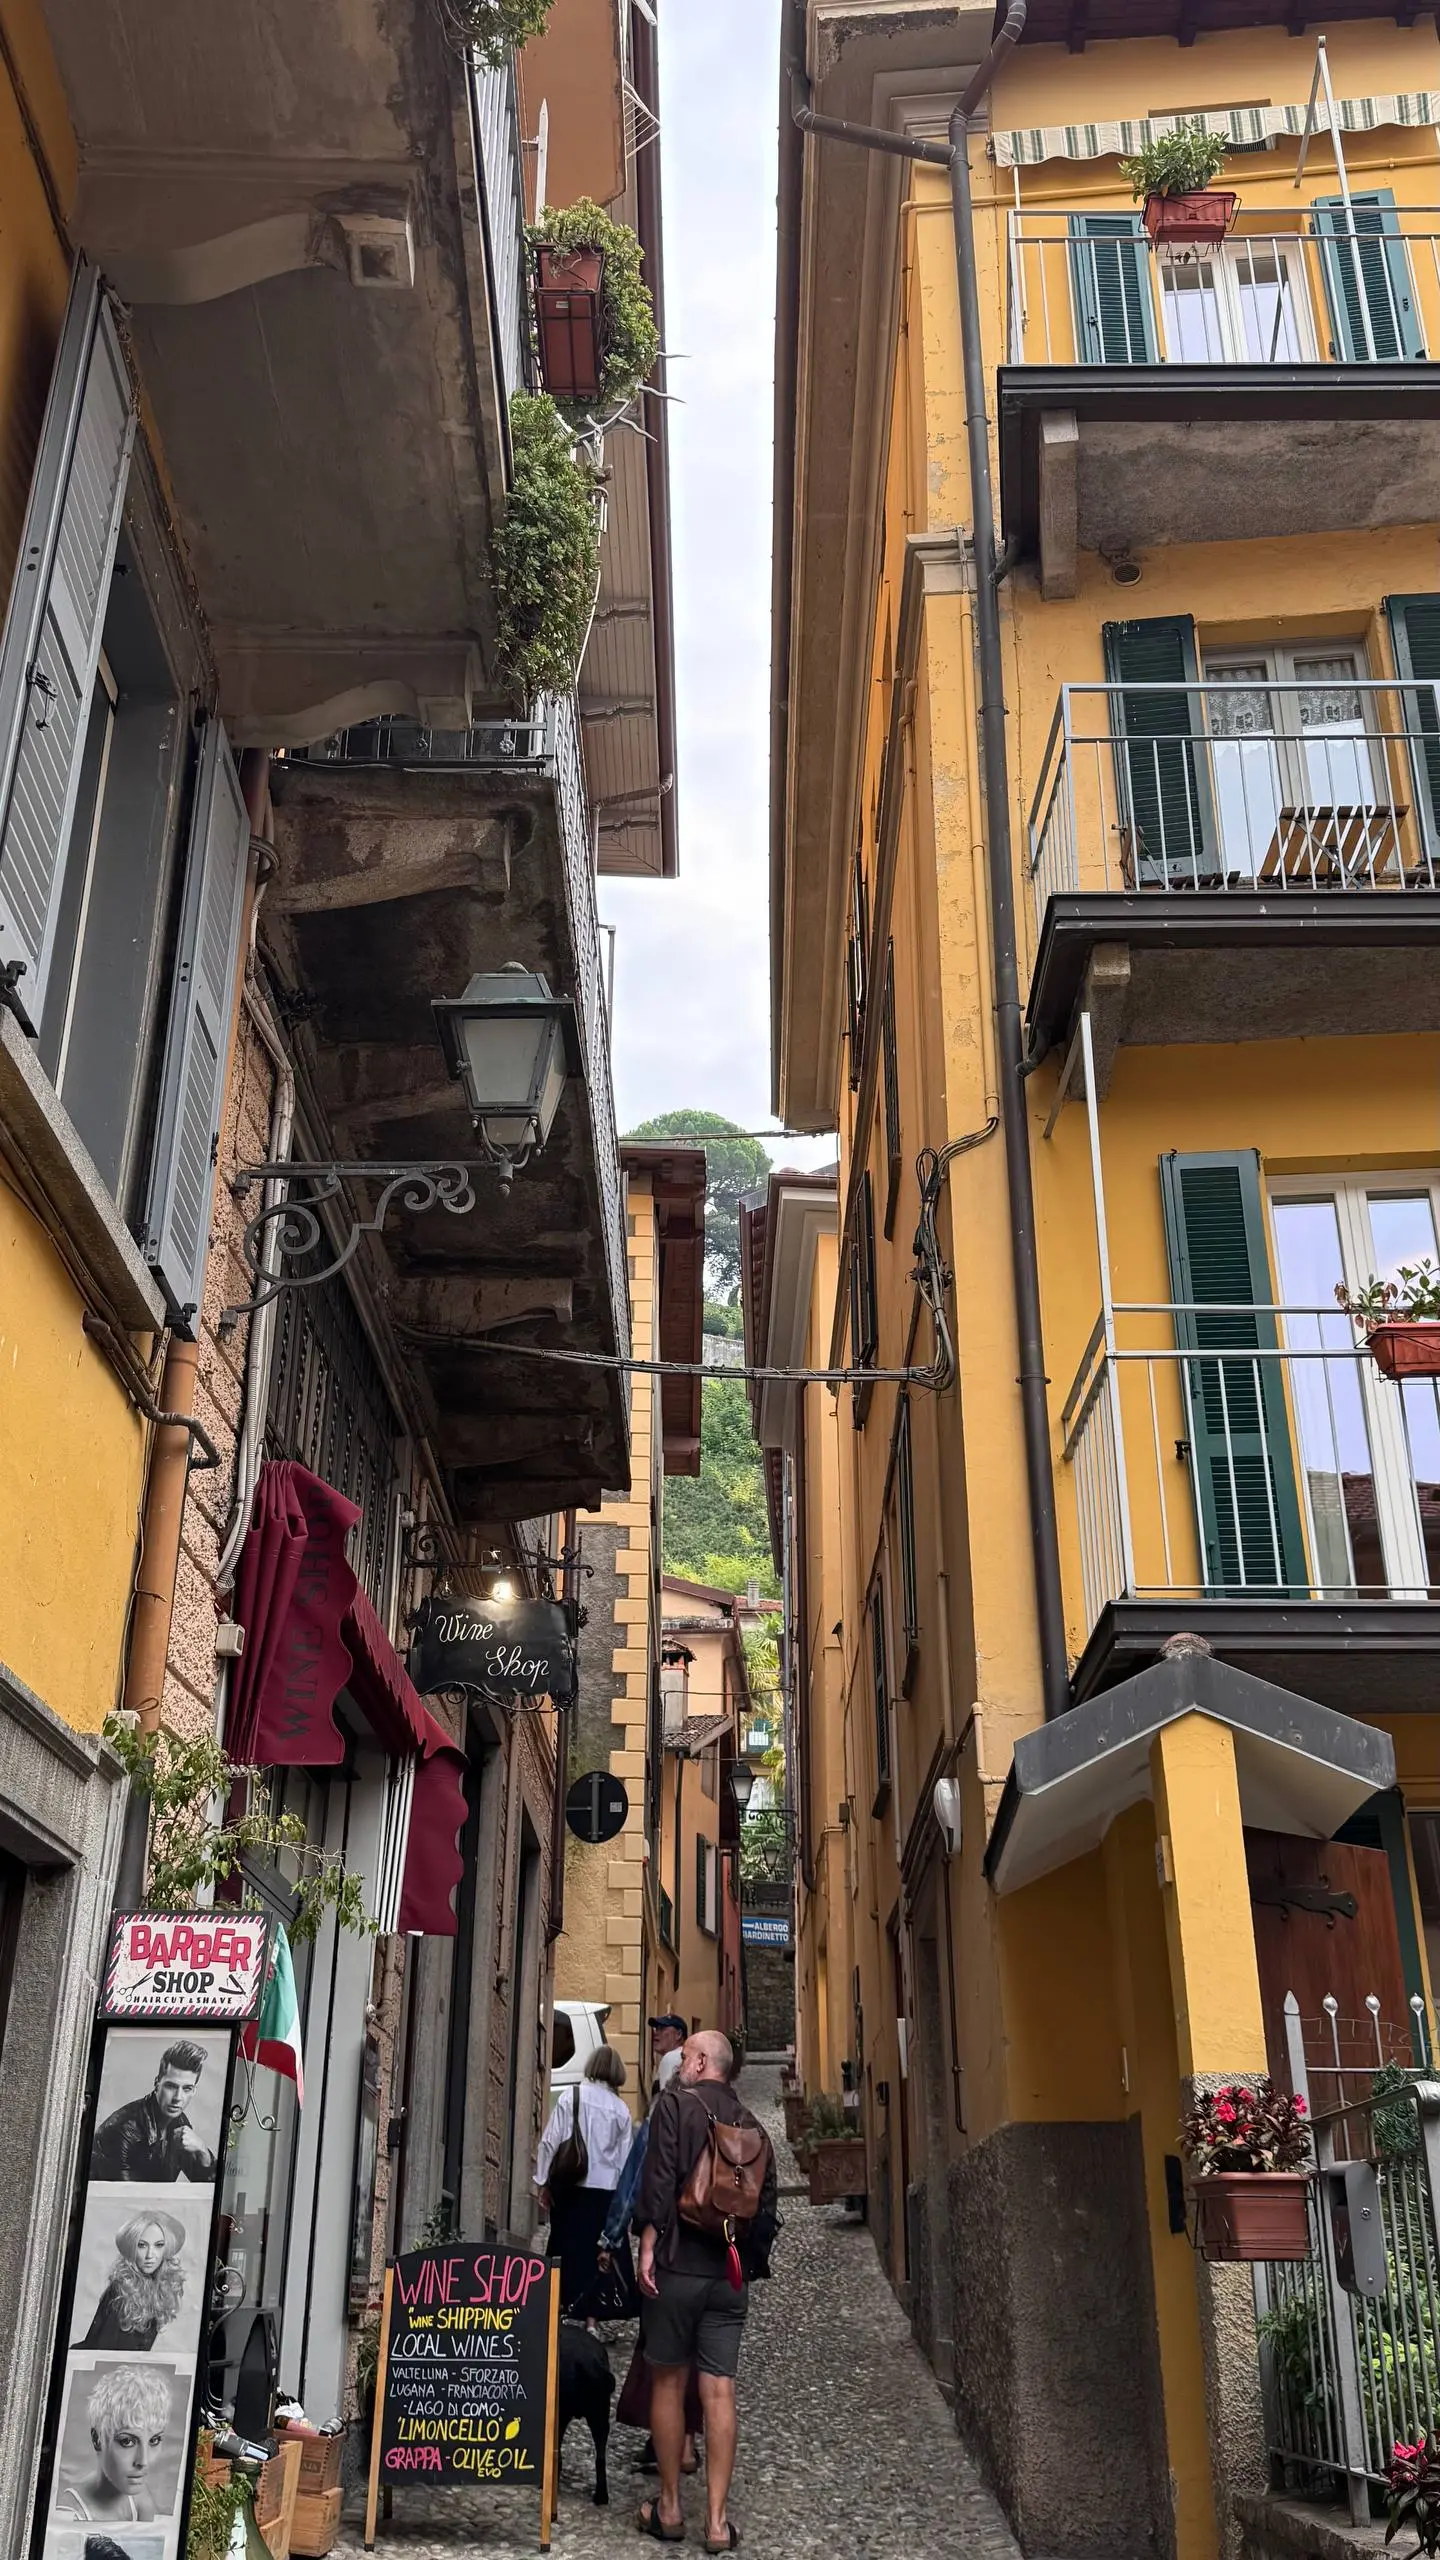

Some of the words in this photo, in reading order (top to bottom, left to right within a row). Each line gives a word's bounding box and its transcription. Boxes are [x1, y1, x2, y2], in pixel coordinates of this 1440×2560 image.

[295, 1486, 333, 1606] SHOP
[435, 1613, 494, 1643] Wine
[485, 1645, 551, 1688] Shop
[279, 1624, 323, 1740] WINE
[754, 1922, 789, 1932] ALBERGO
[130, 1925, 252, 1972] BARBER
[152, 1971, 215, 1994] SHOP
[133, 1996, 185, 2004] HAIRCUT
[196, 1996, 233, 2005] SHAVE
[395, 2258, 465, 2305] WINE
[469, 2254, 545, 2306] SHOP
[391, 2333, 447, 2358] LOCAL
[392, 2367, 449, 2381] VALTELLINA
[460, 2367, 519, 2384] SFORZATO
[390, 2383, 435, 2398] LUGANA
[448, 2402, 458, 2416] DI
[385, 2446, 442, 2472] GRAPPA
[453, 2448, 496, 2469] OLIVE
[498, 2448, 535, 2470] OIL
[478, 2468, 501, 2478] EVO
